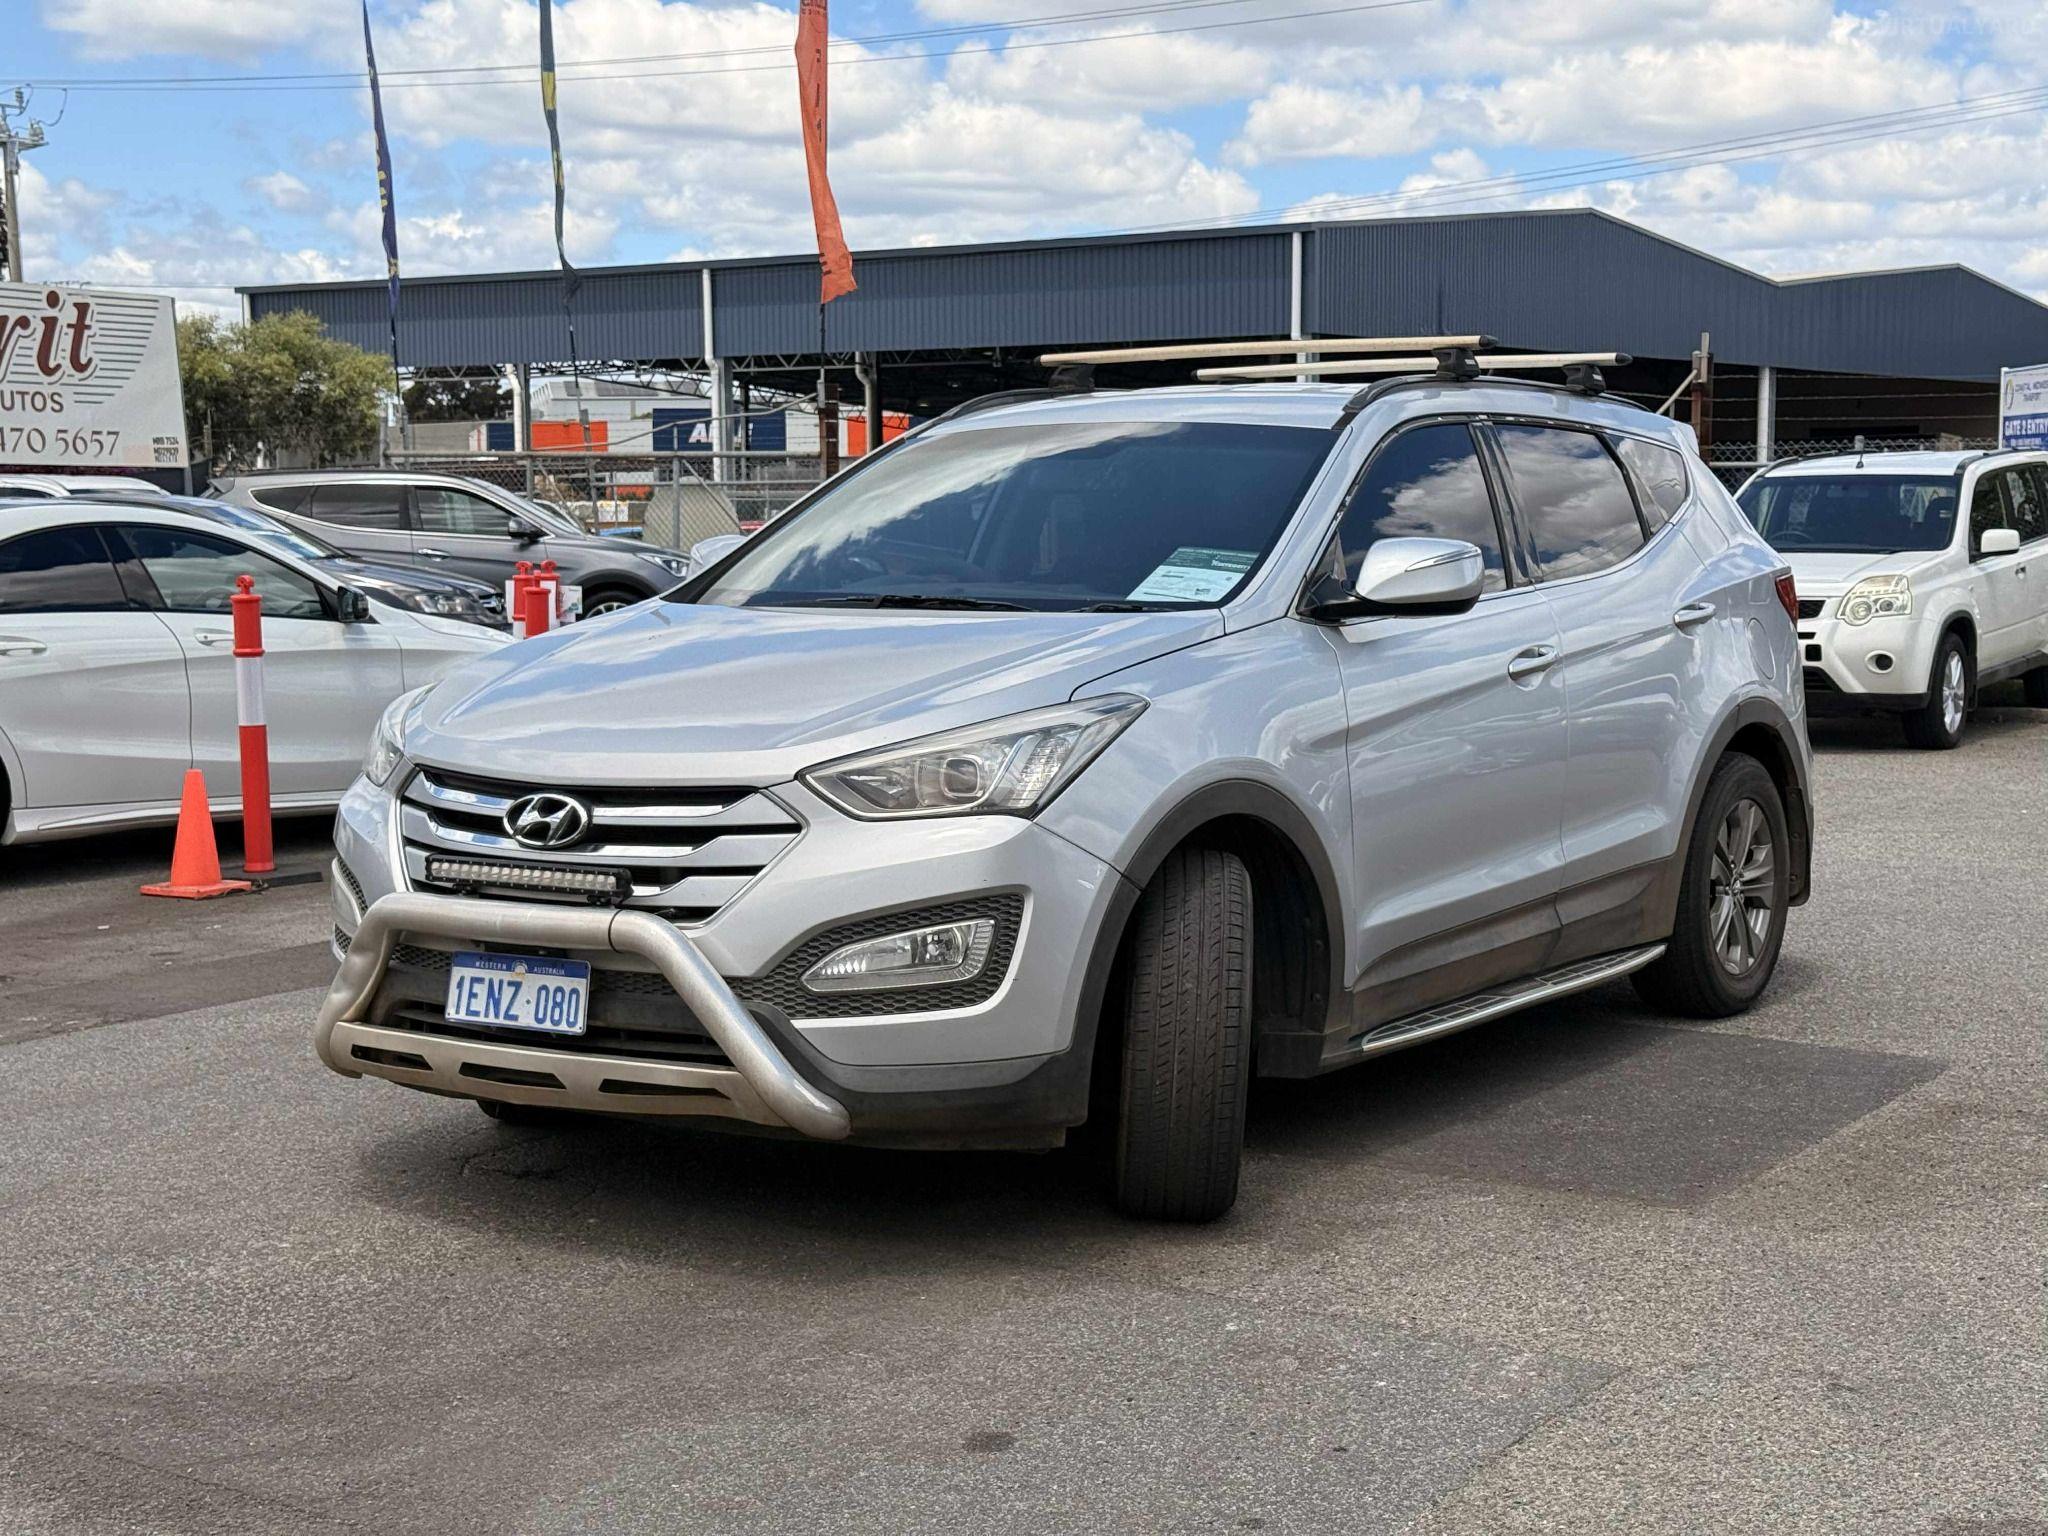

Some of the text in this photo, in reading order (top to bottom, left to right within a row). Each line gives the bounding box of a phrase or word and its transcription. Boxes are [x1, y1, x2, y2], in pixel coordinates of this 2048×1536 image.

[55, 427, 120, 458] 5657
[475, 961, 565, 976] WESTERN AUSTRALIA
[454, 975, 581, 1028] 1ENZ 080
